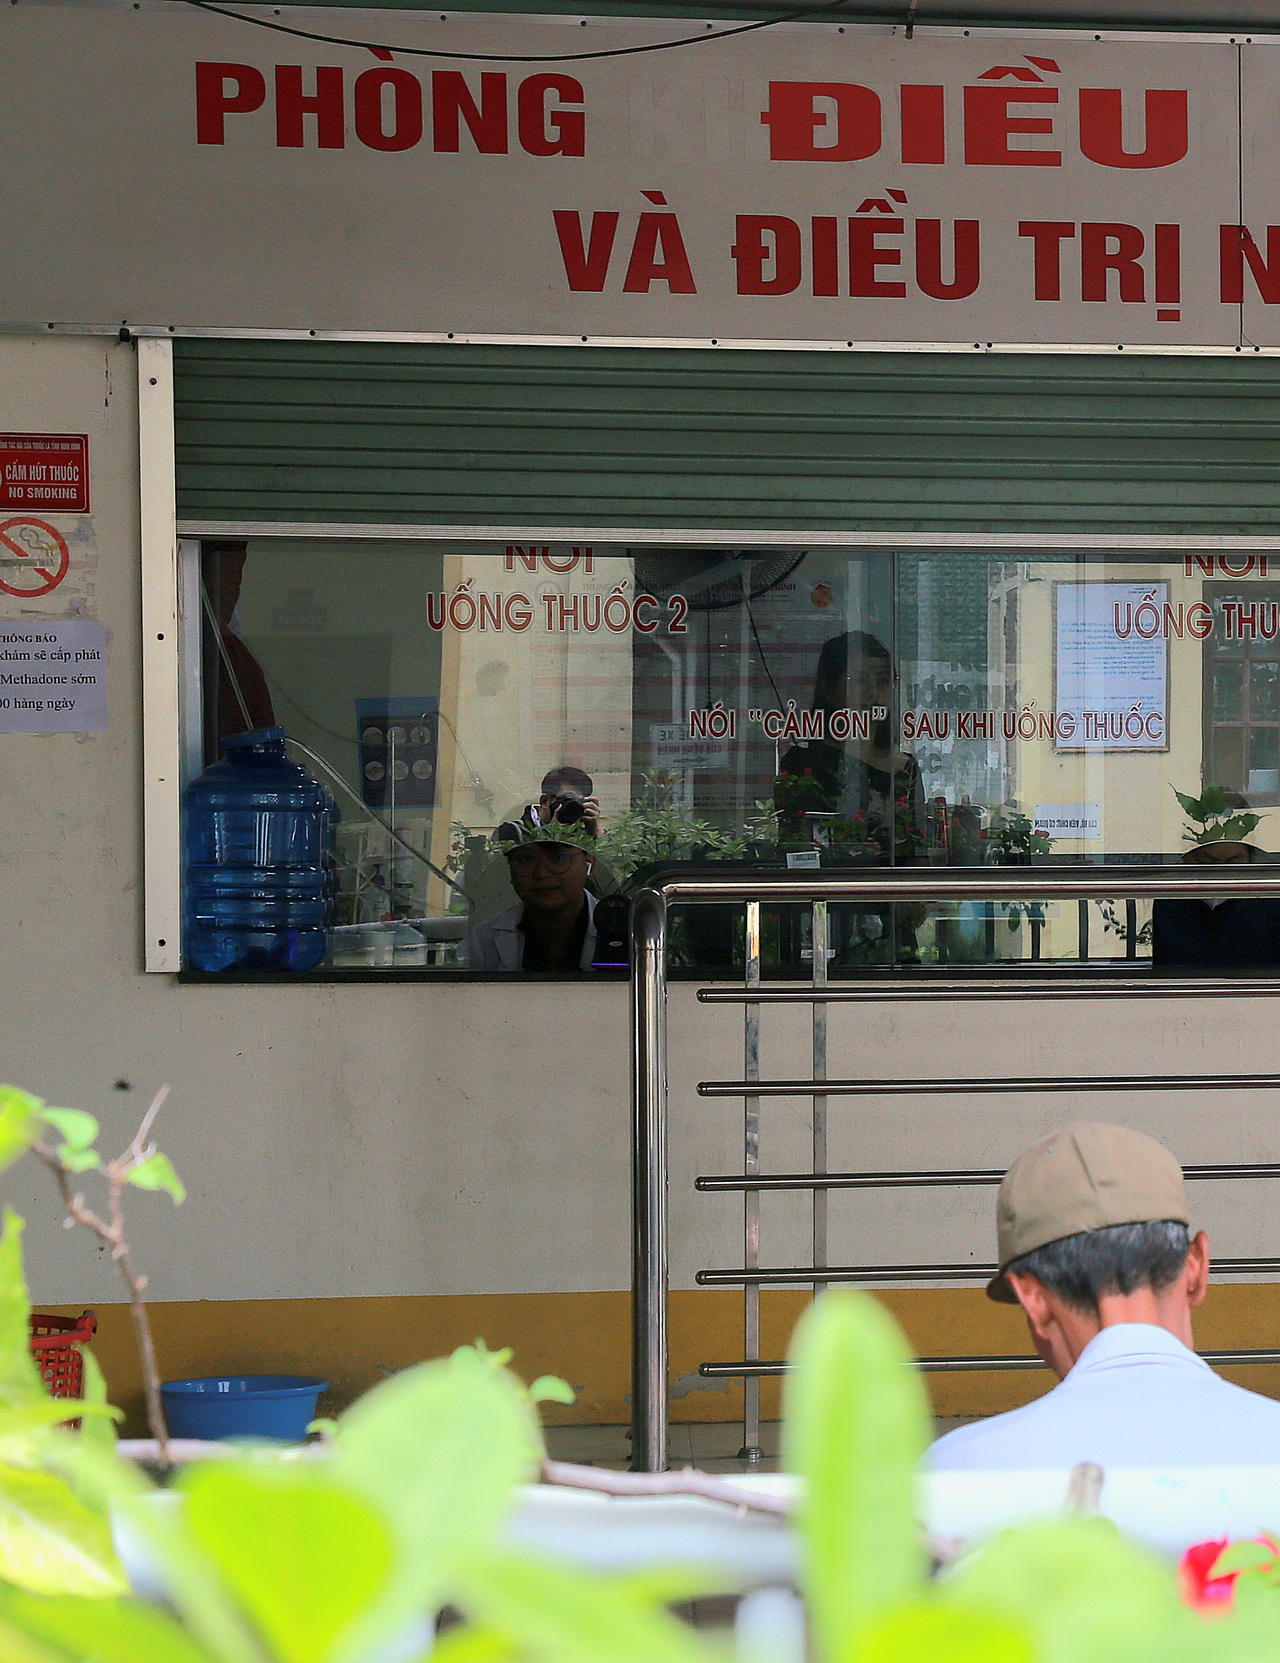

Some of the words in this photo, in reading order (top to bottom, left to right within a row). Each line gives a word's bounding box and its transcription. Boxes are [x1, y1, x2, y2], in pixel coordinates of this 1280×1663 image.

[196, 46, 585, 157] PHÒNG
[760, 55, 1188, 169] ĐIỀU
[553, 191, 697, 295] VÀ
[731, 189, 979, 300] ĐIỀU
[1019, 221, 1180, 321] TRỊ
[5, 459, 26, 480] CẤM
[29, 462, 47, 481] HÚT
[49, 460, 79, 481] THUỐC
[9, 487, 23, 498] NO
[27, 487, 77, 499] SMOKING
[427, 578, 533, 632] UỐNG
[542, 579, 658, 633] THUỐC
[668, 594, 688, 633] 2
[1113, 588, 1214, 640] UỐNG
[35, 633, 57, 643] BÁO
[34, 650, 47, 660] sẽ
[50, 647, 71, 662] cấp
[75, 649, 101, 662] phát
[1, 674, 67, 685] Methadone
[71, 673, 96, 684] sớm
[14, 698, 43, 711] hàng
[47, 697, 75, 711] ngày
[690, 701, 735, 738] NÓI
[902, 711, 950, 740] SAU
[956, 711, 995, 740] KHI
[1002, 699, 1075, 740] UỐNG
[1082, 701, 1164, 740] THUỐC
